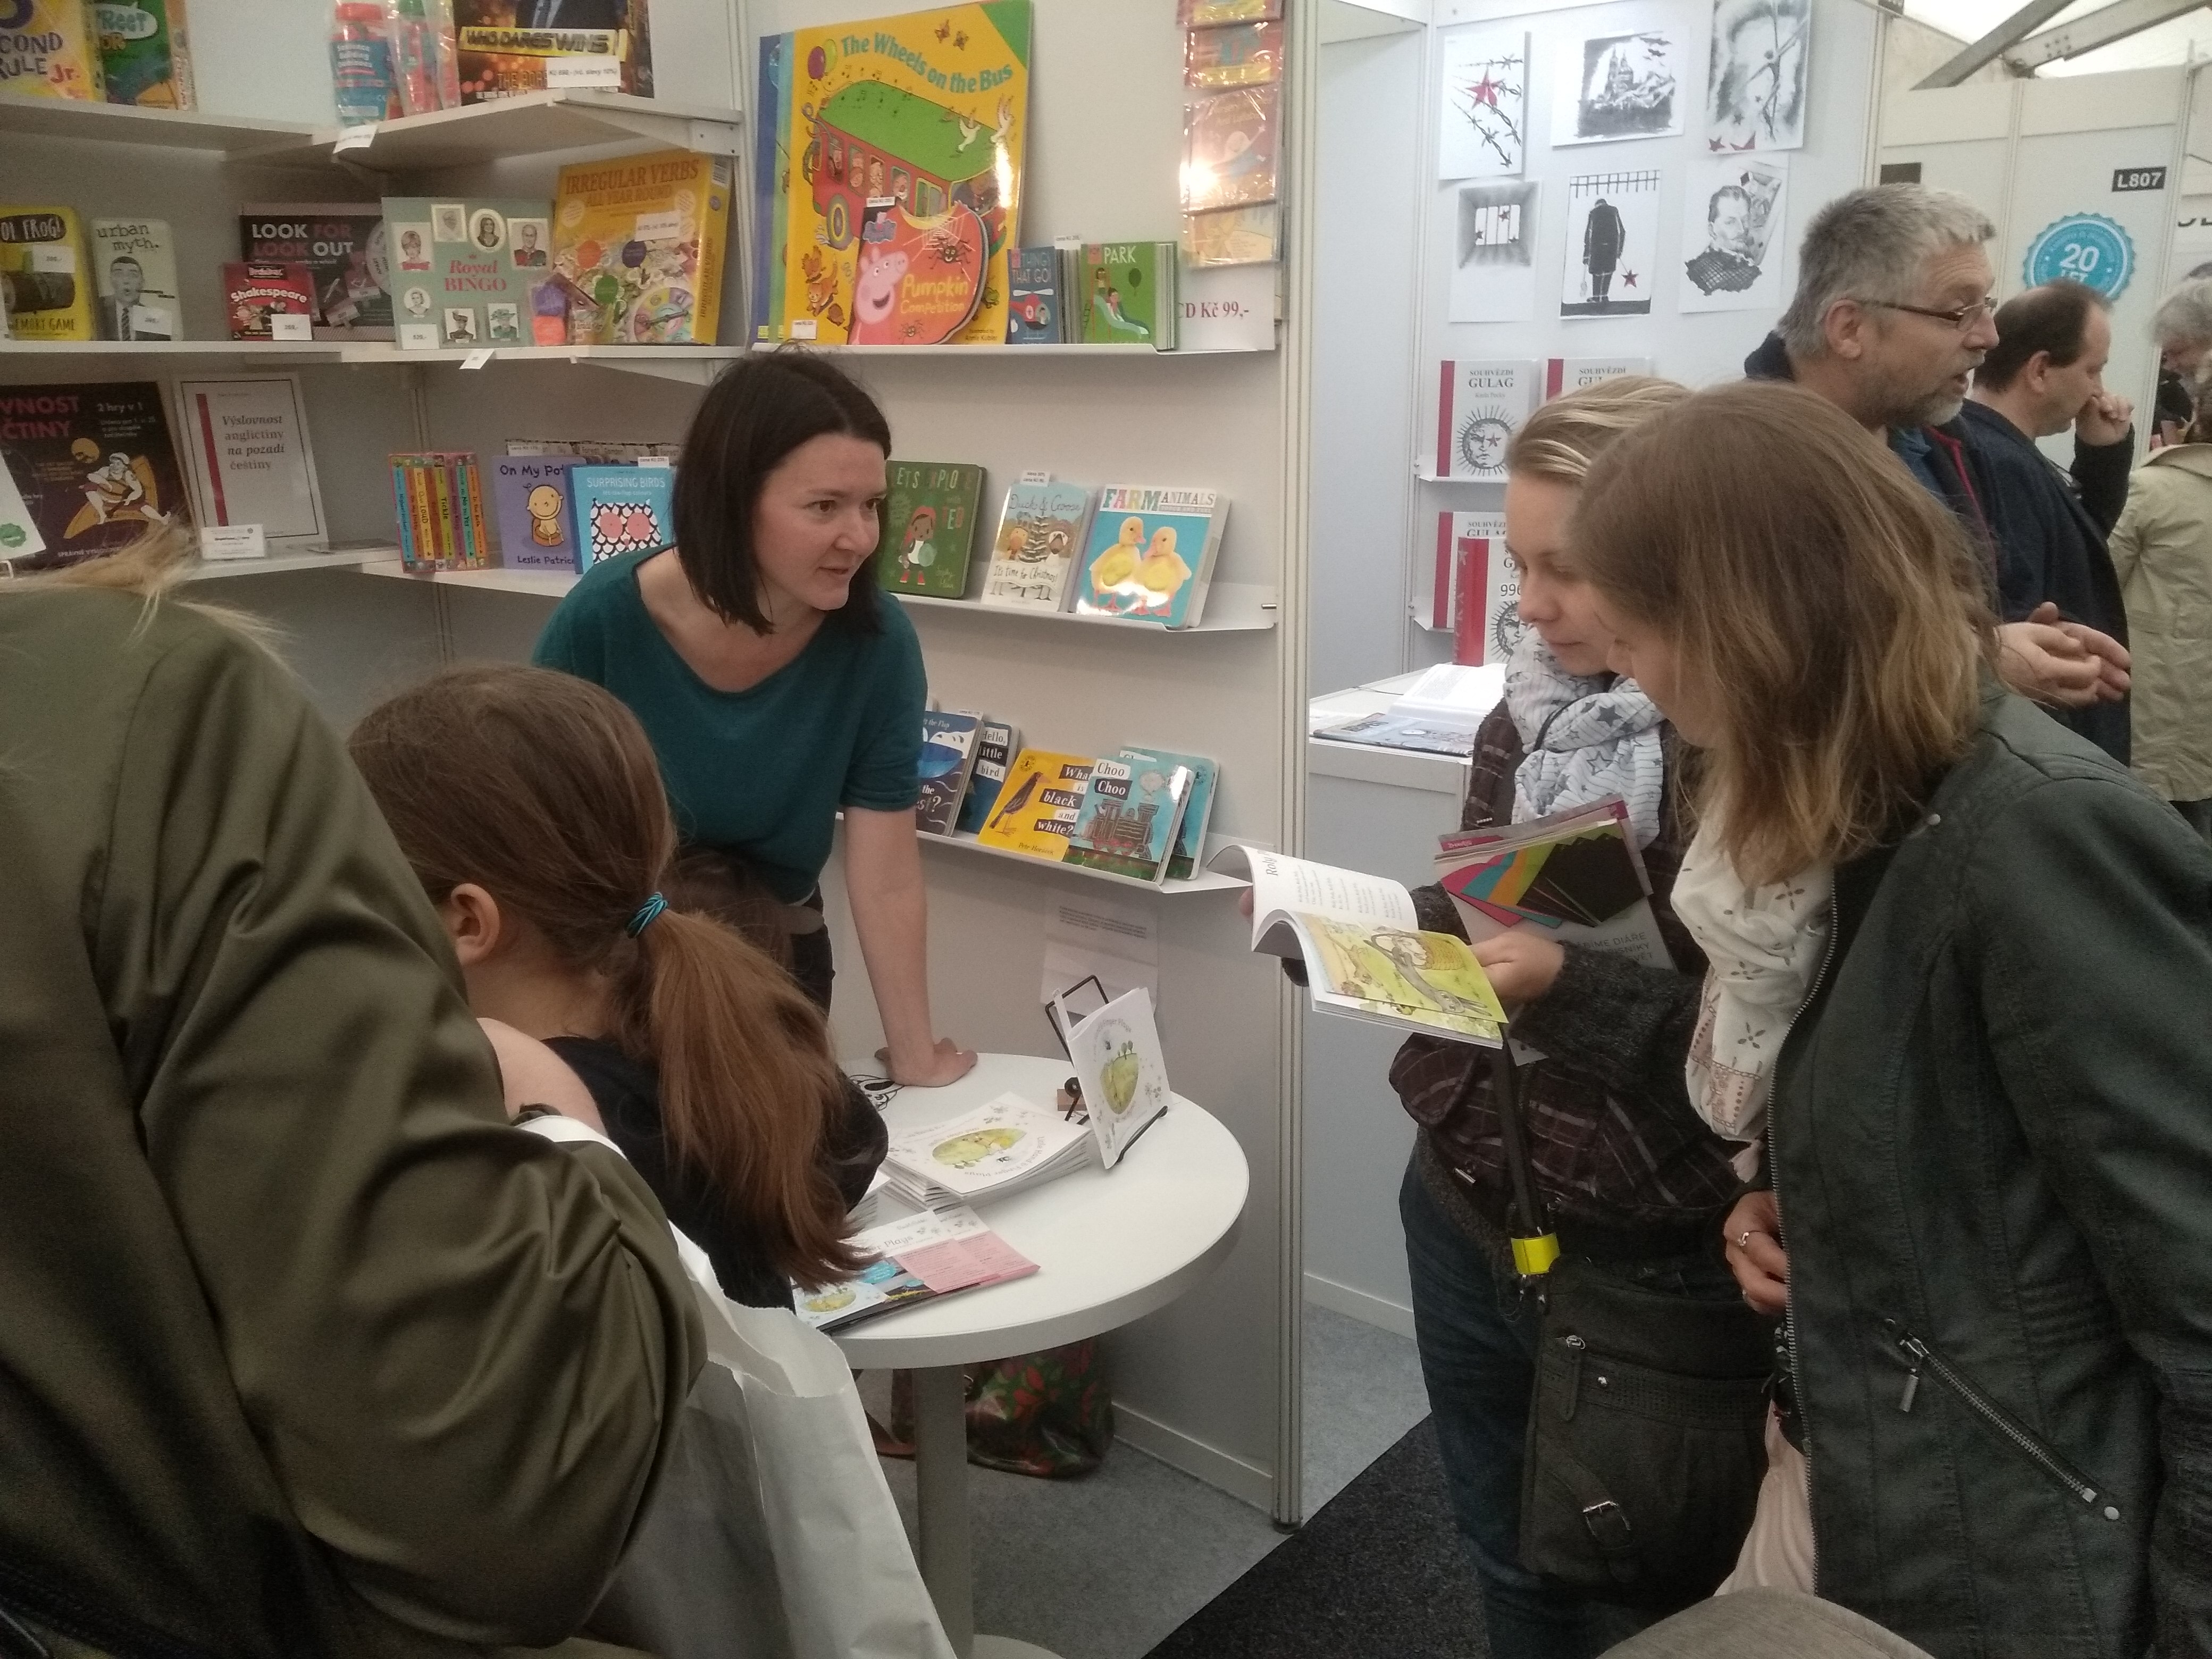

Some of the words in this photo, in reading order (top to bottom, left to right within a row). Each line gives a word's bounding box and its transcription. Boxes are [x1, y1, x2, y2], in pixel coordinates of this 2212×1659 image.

[557, 33, 609, 53] WINS
[841, 35, 869, 57] The
[874, 32, 927, 76] Wheels
[927, 68, 948, 90] on
[949, 72, 977, 93] the
[979, 64, 1013, 91] Bus
[566, 165, 646, 195] IRREGULAR
[650, 159, 699, 184] VERBS
[2117, 171, 2162, 189] L807
[23, 217, 61, 239] FROG!
[96, 224, 149, 238] urban
[252, 224, 308, 238] LOOK
[313, 224, 352, 238] FOR
[112, 237, 159, 254] myth.
[254, 242, 309, 256] LOOK
[312, 241, 354, 257] OUT
[1104, 246, 1137, 264] PARK
[2059, 243, 2100, 272] 20
[450, 259, 498, 279] Royal
[445, 278, 507, 291] BINGO
[903, 273, 968, 302] Pumpkin
[230, 287, 307, 303] Shakespeare
[901, 299, 965, 315] Competition
[1201, 301, 1218, 319] Kč
[1468, 378, 1514, 388] GULAG
[1578, 376, 1604, 387] GU
[222, 415, 282, 427] Výslovnost
[228, 447, 242, 456] na
[500, 465, 516, 476] On
[522, 464, 540, 478] My
[587, 477, 638, 488] SURPRISING
[640, 477, 665, 488] BIRDS
[1009, 493, 1037, 510] Duck
[1039, 497, 1048, 511] &
[1051, 494, 1081, 512] Goose
[1103, 488, 1162, 512] FARM
[1161, 491, 1215, 506] ANIMALS
[441, 497, 449, 520] Tickle
[517, 555, 541, 564] Leslie
[1005, 565, 1018, 577] time
[983, 730, 1006, 744] Hello,
[978, 747, 1003, 759] little
[981, 767, 1000, 777] bird
[1065, 766, 1092, 781] What
[1097, 762, 1125, 777] Choo
[922, 785, 935, 794] the
[1097, 780, 1126, 795] Choo
[1043, 791, 1077, 807] black
[1058, 811, 1076, 820] and
[1037, 821, 1074, 835] white?
[1262, 857, 1278, 876] Roly
[1037, 1136, 1046, 1149] Little
[1027, 1147, 1043, 1163] Hand
[883, 1235, 914, 1248] Plays
